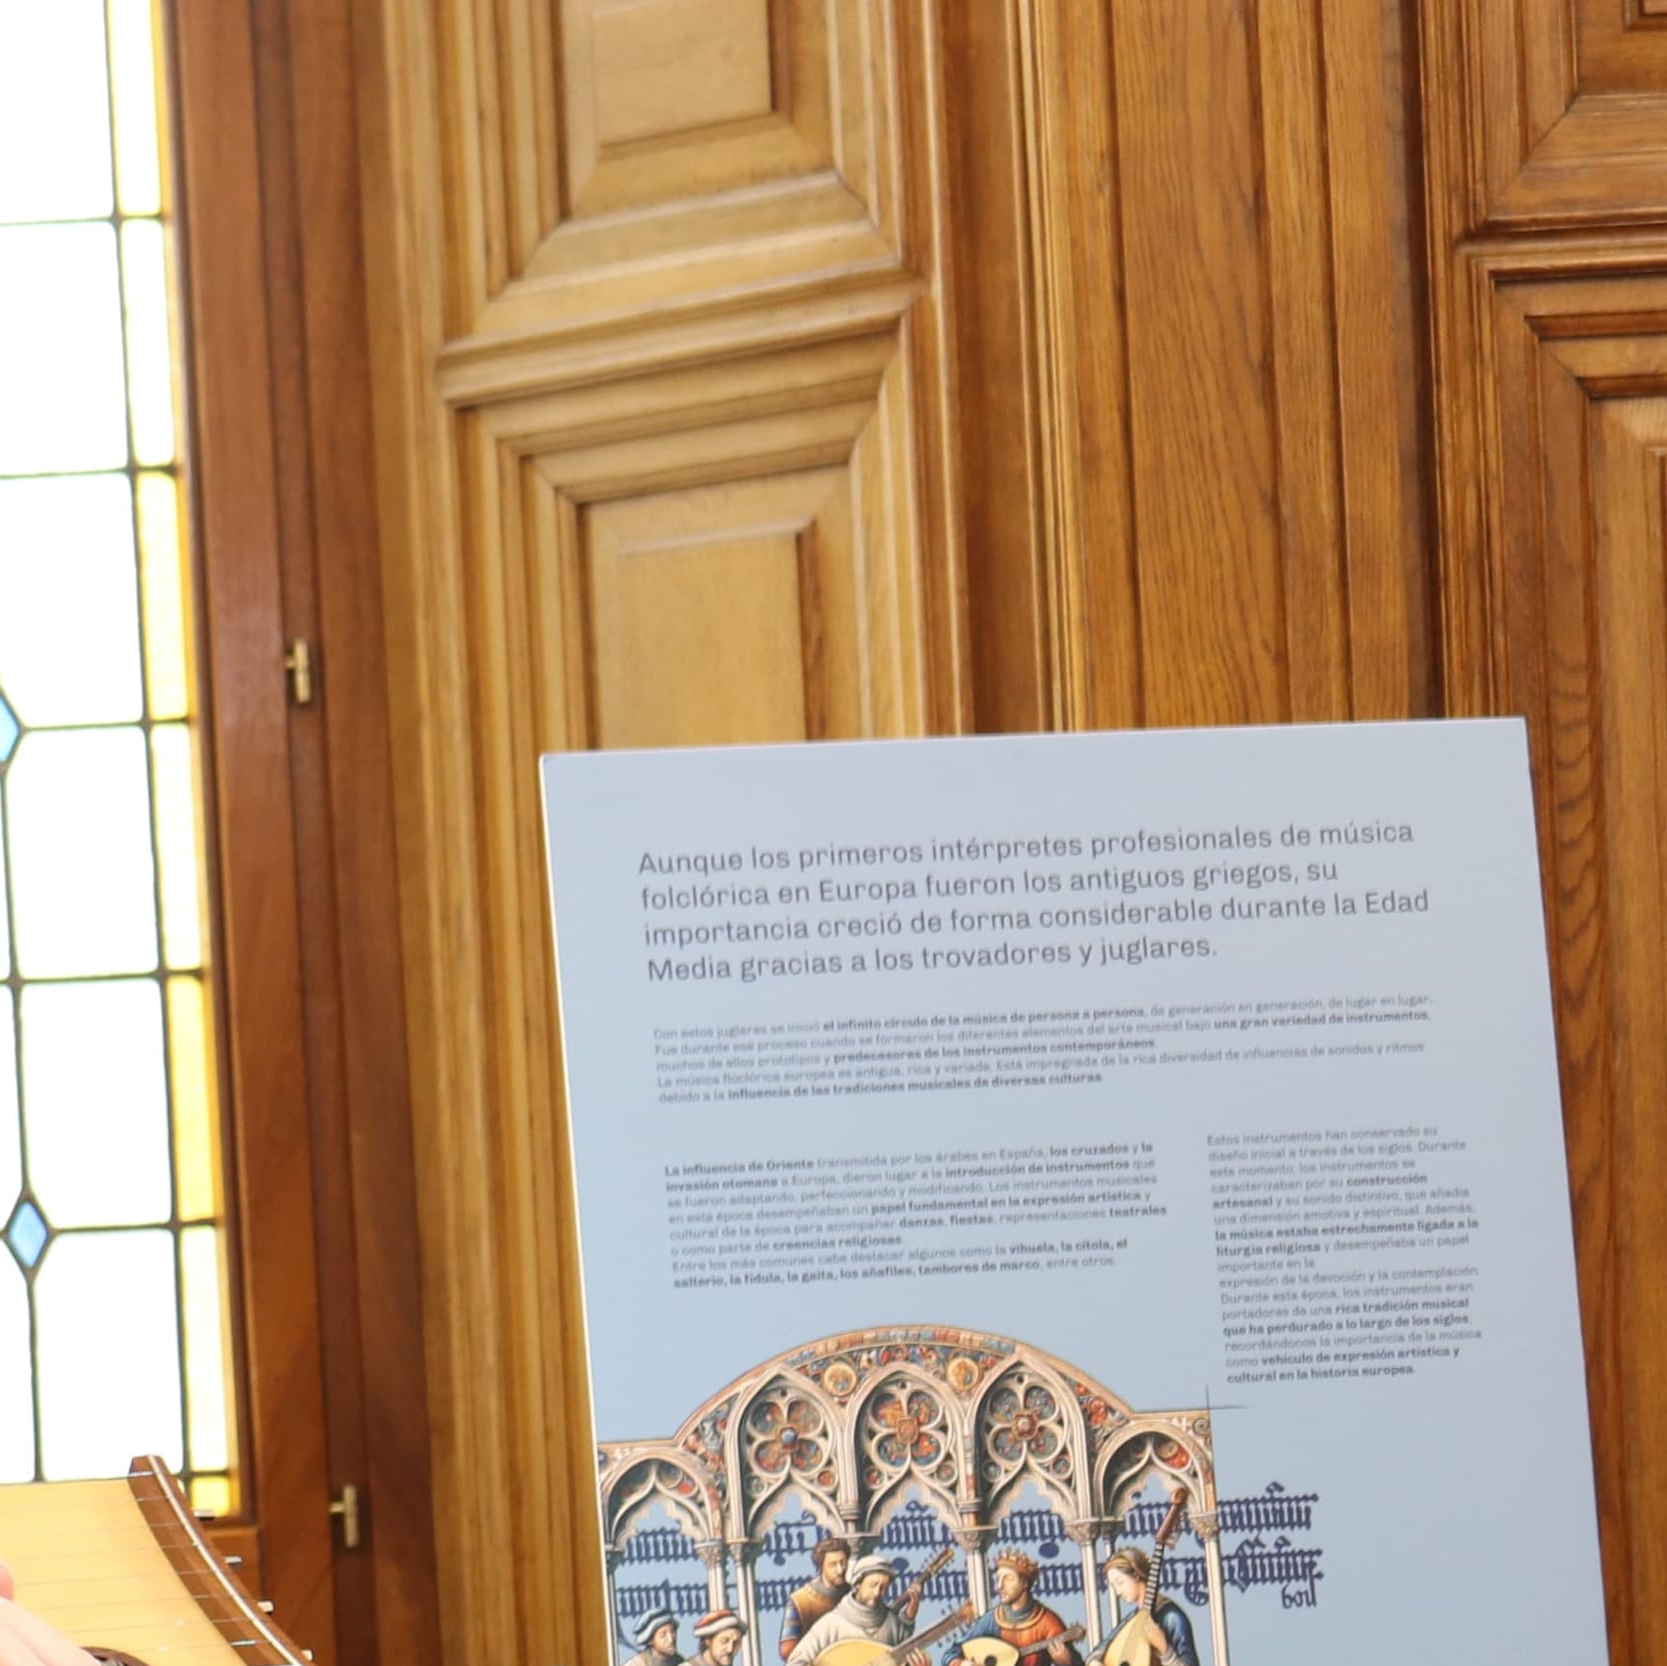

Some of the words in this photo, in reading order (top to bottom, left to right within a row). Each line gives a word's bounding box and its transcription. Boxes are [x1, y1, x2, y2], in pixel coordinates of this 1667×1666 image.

[639, 848, 741, 879] Aunque
[751, 846, 789, 869] los
[799, 841, 922, 872] primeros
[932, 834, 1081, 866] intérpretes
[1091, 825, 1271, 859] profesionales
[1280, 824, 1310, 846] de
[1319, 819, 1412, 844] música
[642, 883, 768, 910] folclórica
[779, 887, 809, 904] en
[819, 876, 915, 907] Europa
[926, 872, 1014, 897] fueron
[1024, 870, 1061, 893] los
[1070, 866, 1184, 896] antiguos
[1193, 861, 1298, 891] griegos,
[1307, 864, 1337, 881] su
[645, 918, 807, 951] importancia
[818, 913, 901, 938] creció
[911, 911, 941, 934] de
[951, 907, 1030, 932] forma
[1039, 899, 1212, 928] considerable
[1221, 894, 1325, 920] durante
[1334, 893, 1356, 915] la
[1365, 889, 1428, 913] Edad
[648, 956, 730, 981] Media
[740, 952, 841, 982] gracias
[851, 956, 865, 972] a
[875, 948, 912, 971] los
[922, 941, 1070, 969] trovadores
[1079, 945, 1091, 967] y
[1101, 934, 1215, 966] juglares.
[1227, 1370, 1276, 1383] cultural
[1279, 1372, 1294, 1380] en
[1296, 1368, 1308, 1379] la
[1310, 1366, 1359, 1379] historia
